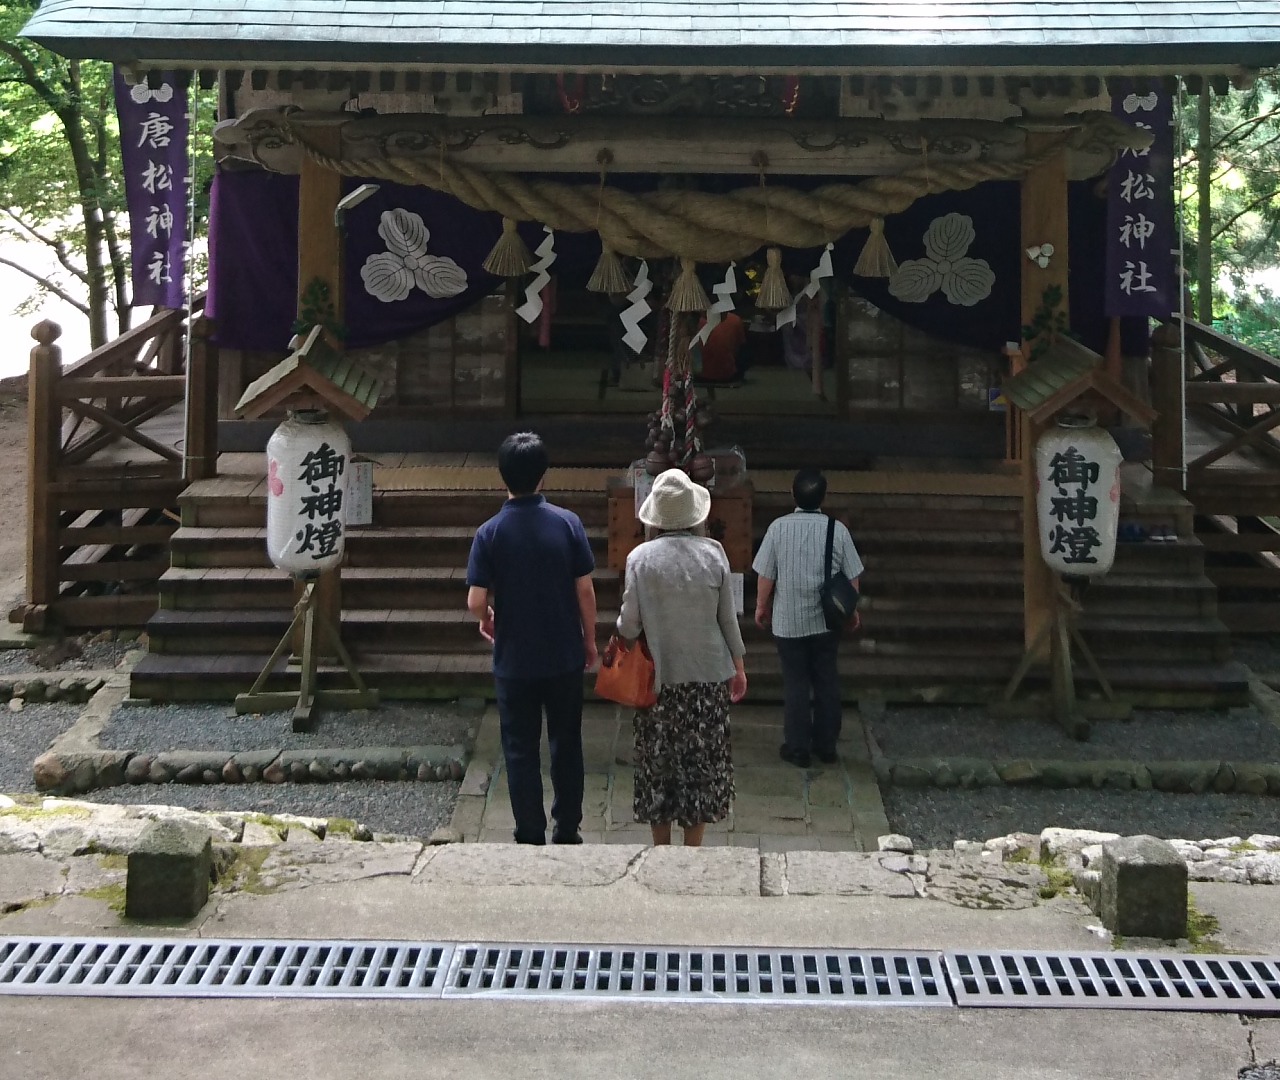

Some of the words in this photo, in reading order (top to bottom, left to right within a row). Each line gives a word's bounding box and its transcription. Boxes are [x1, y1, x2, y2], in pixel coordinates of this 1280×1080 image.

[137, 112, 175, 286] 唐松神社
[1119, 121, 1158, 297] 松神社
[295, 441, 345, 560] 御神燈
[1047, 445, 1103, 564] 御神燈
